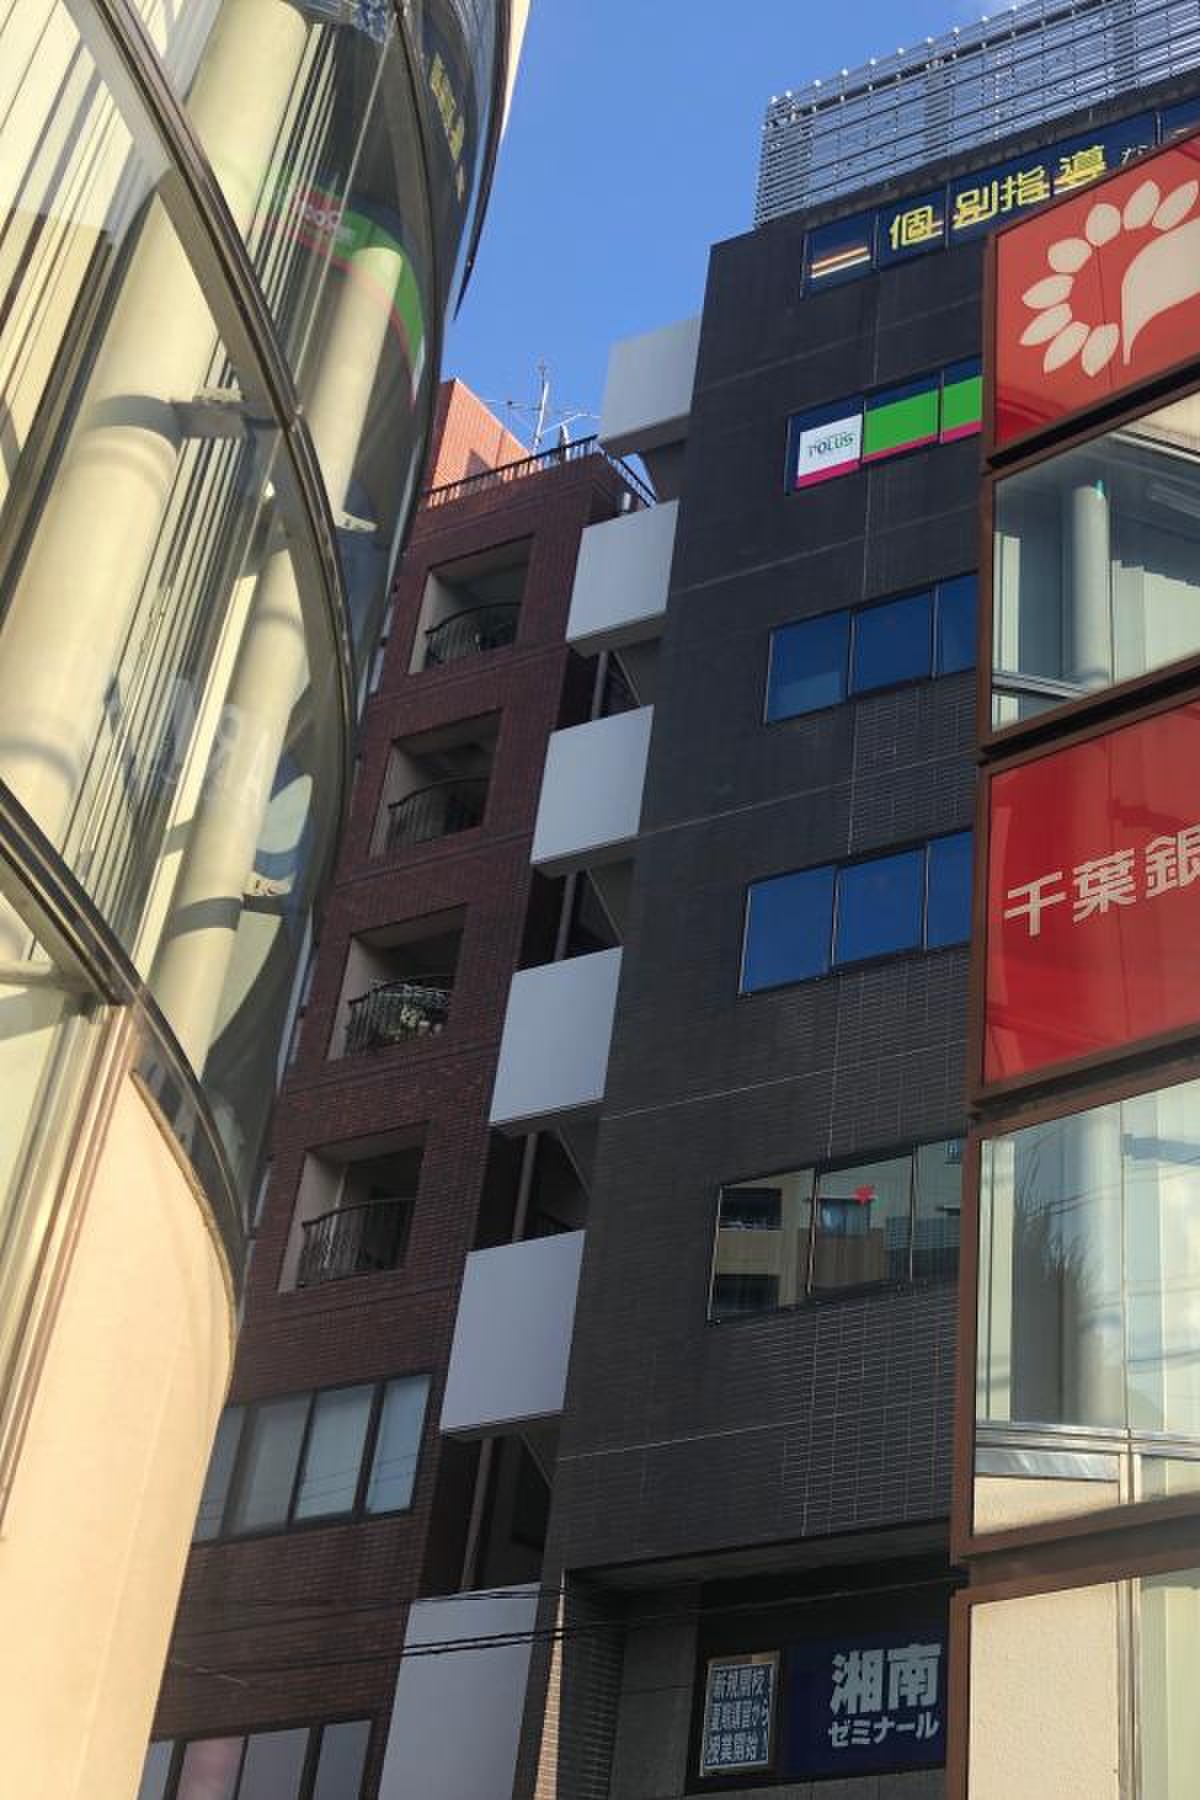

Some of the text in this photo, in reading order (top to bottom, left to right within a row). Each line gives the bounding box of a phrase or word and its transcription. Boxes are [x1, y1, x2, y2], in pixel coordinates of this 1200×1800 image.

[889, 145, 1107, 251] 個別指導
[830, 1643, 942, 1715] 湘南
[828, 1711, 940, 1748] ゼミナール
